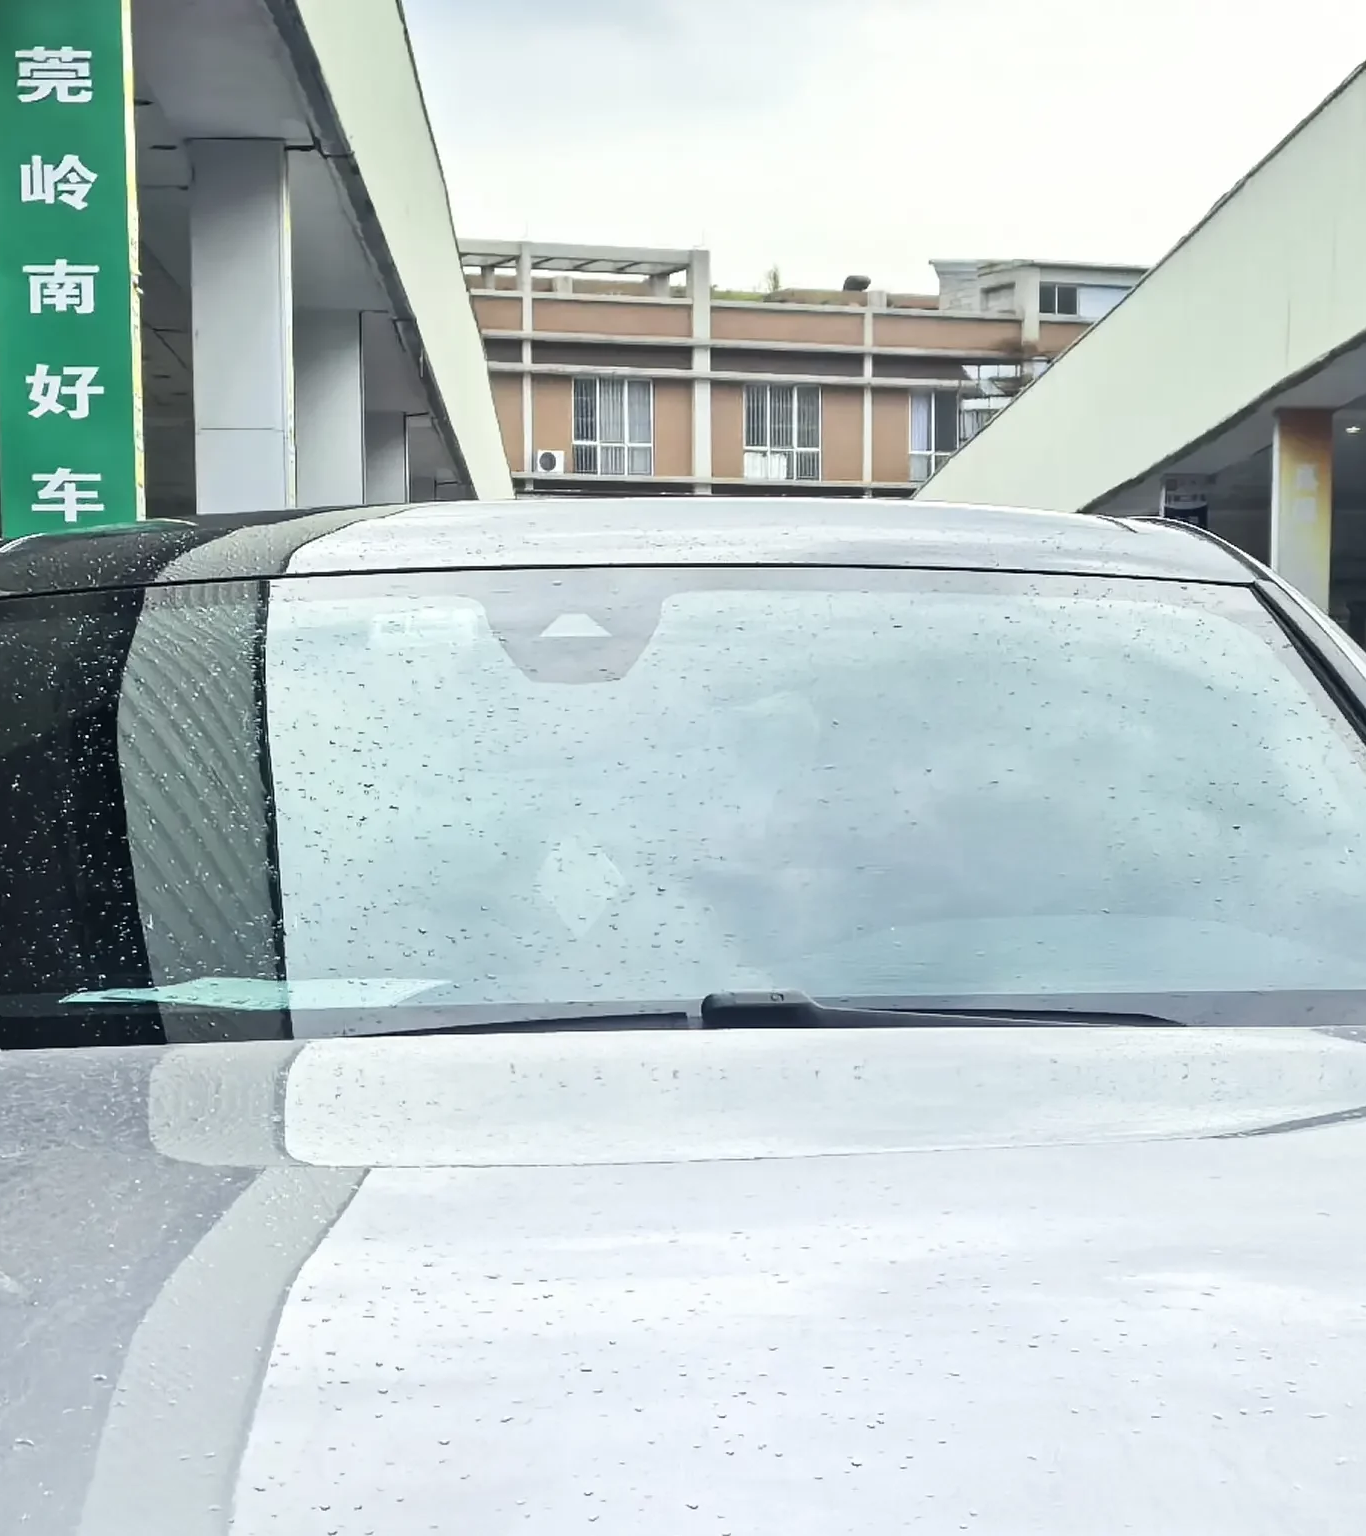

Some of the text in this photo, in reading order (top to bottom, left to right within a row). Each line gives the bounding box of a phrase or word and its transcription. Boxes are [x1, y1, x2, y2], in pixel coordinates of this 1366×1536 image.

[15, 46, 105, 523] 莞岭南好车
